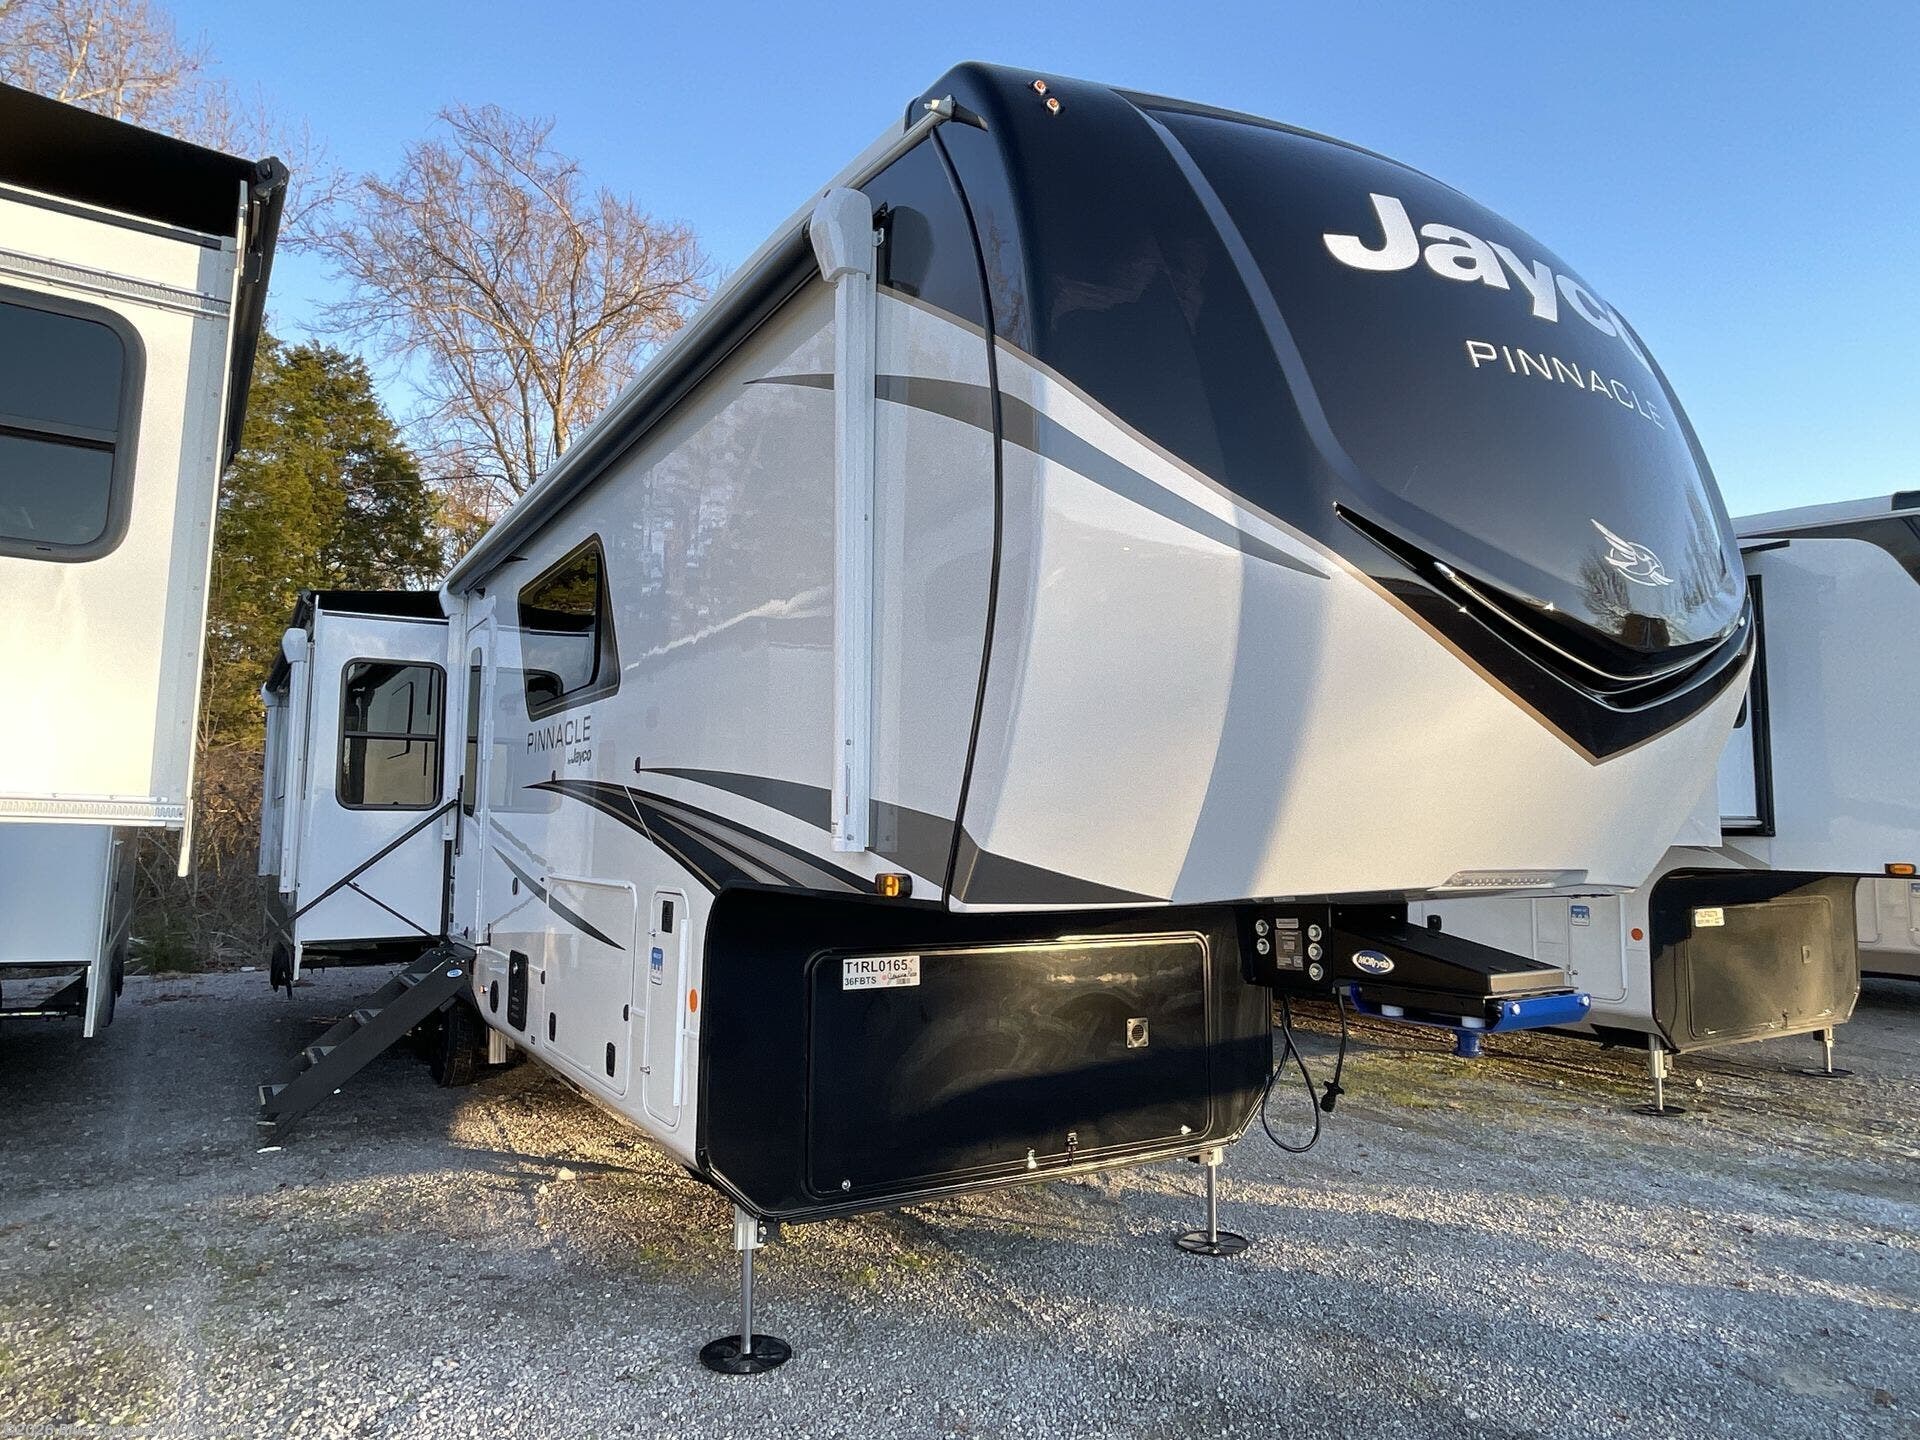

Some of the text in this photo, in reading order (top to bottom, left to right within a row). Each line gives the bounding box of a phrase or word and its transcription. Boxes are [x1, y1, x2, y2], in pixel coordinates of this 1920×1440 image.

[1466, 339, 1665, 429] PINNACLE
[526, 715, 591, 754] PINNACLE
[571, 748, 592, 766] Jayco
[845, 959, 908, 974] T1RL0165
[844, 976, 877, 986] 36FBTS
